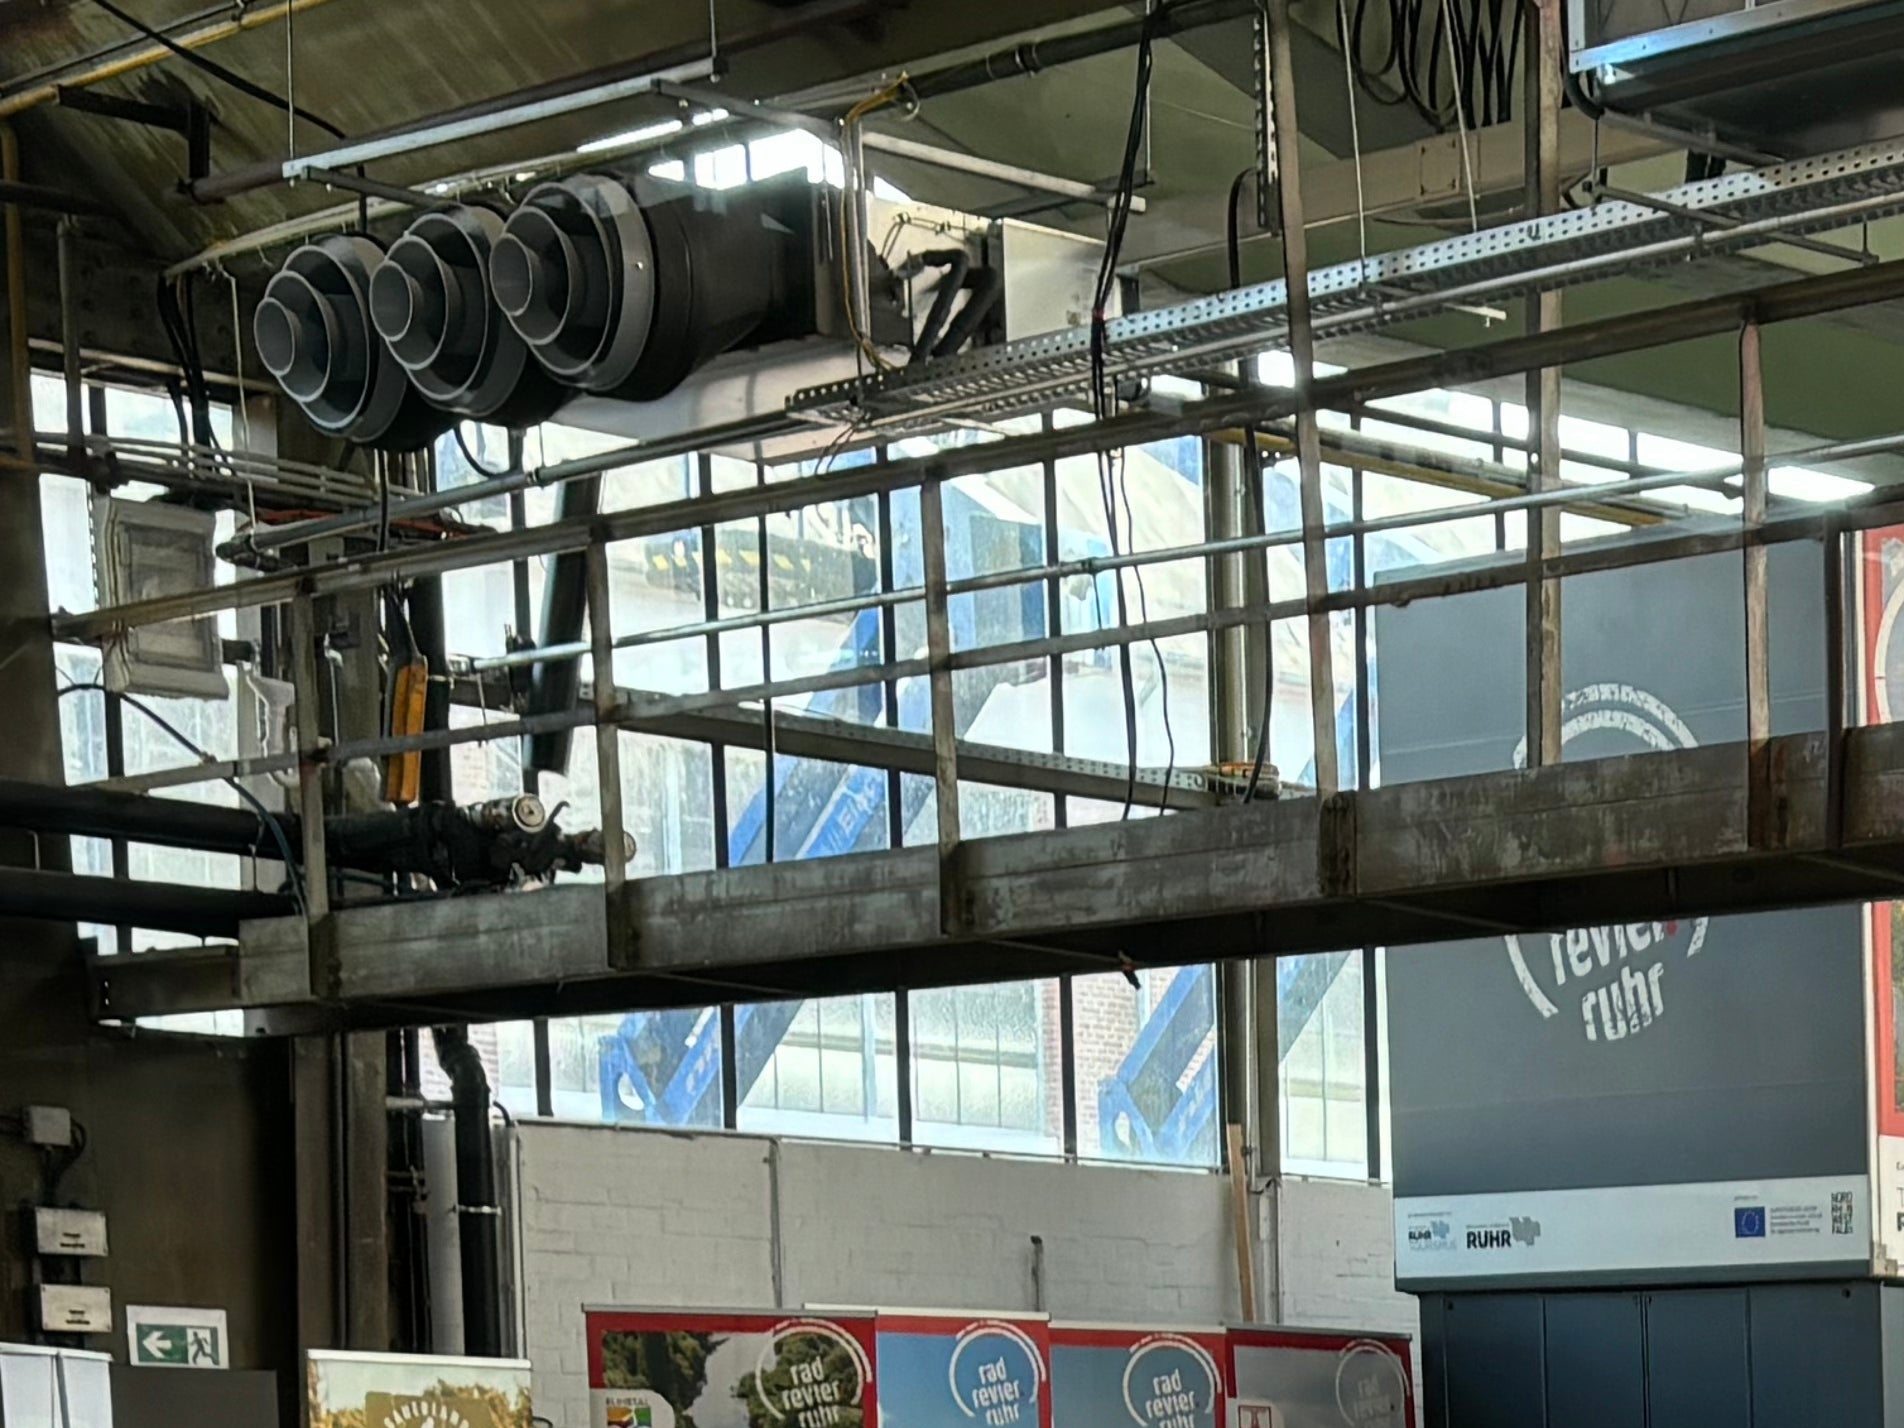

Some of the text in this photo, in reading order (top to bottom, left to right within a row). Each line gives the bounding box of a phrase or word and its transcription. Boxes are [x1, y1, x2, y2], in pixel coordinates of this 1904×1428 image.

[1581, 961, 1664, 1041] ruhr
[1466, 1229, 1511, 1249] RUHR
[790, 1356, 825, 1384] rad
[978, 1356, 1006, 1384] rad
[1152, 1368, 1182, 1395] rad
[781, 1378, 841, 1411] revier
[972, 1378, 1021, 1410] revier
[1145, 1390, 1196, 1420] revier
[985, 1405, 1021, 1427] ruhr
